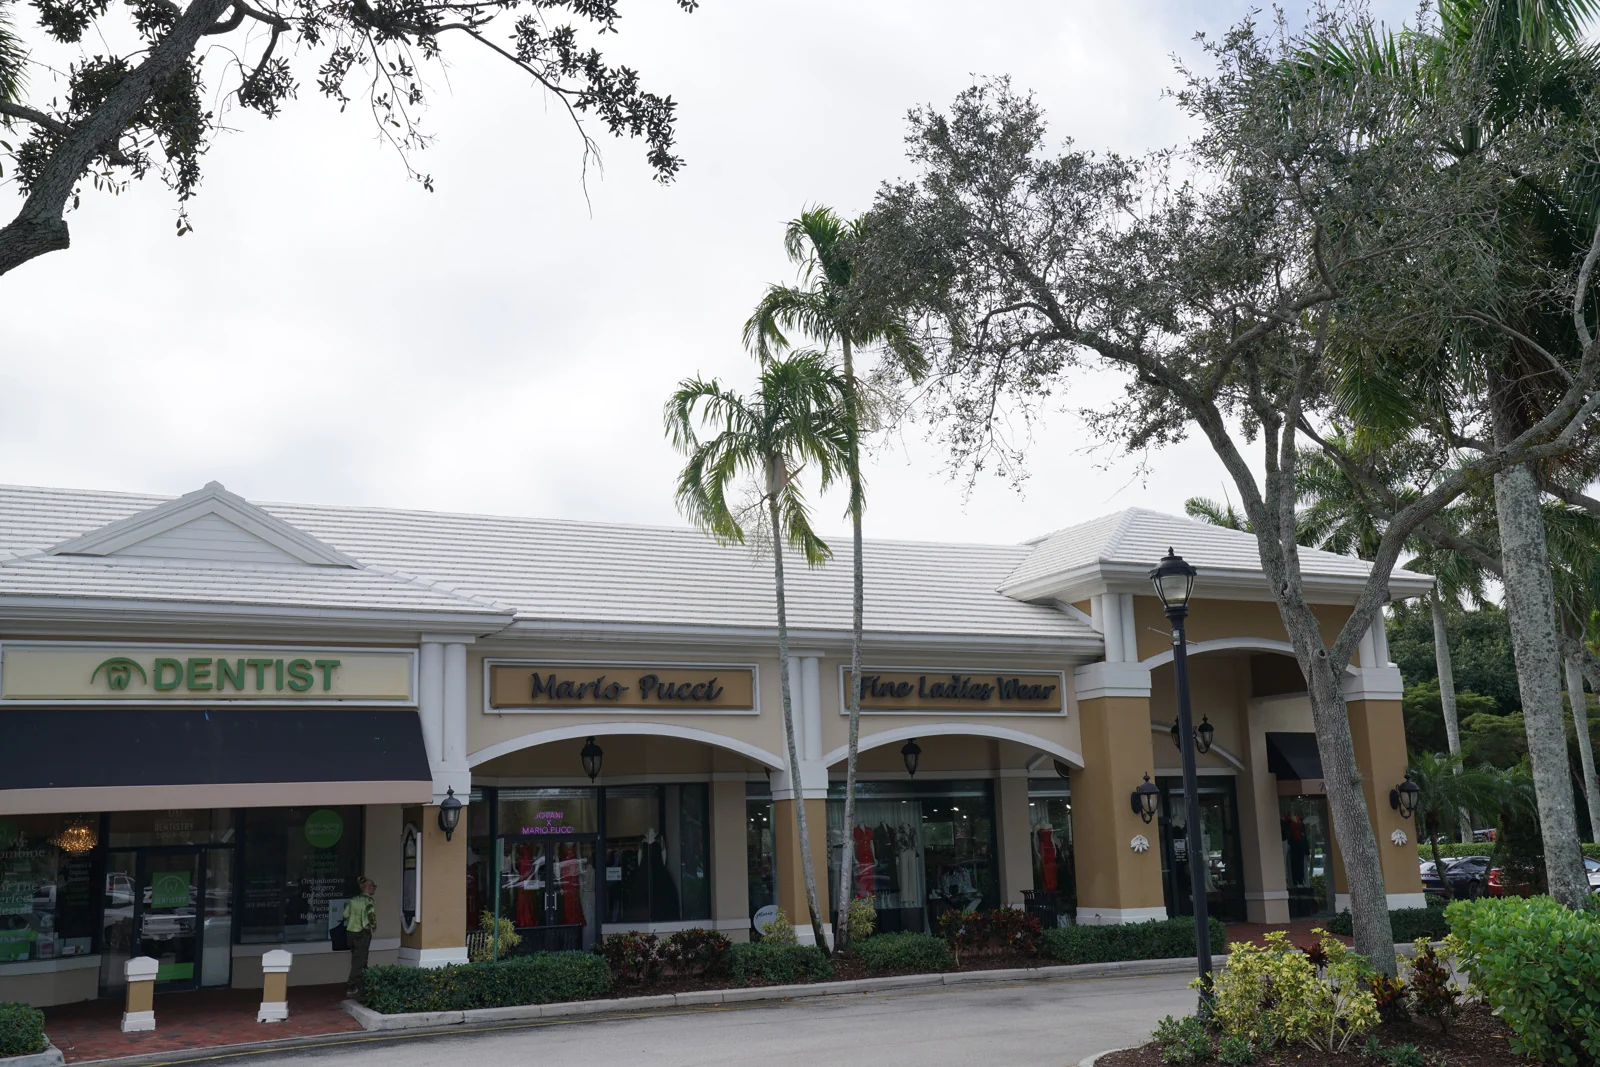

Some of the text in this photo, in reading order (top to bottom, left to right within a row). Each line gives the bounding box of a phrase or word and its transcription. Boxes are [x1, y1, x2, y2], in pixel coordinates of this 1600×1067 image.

[154, 658, 340, 691] DENTIST
[532, 672, 723, 701] Mario Pucci
[860, 675, 1056, 701] Fine Ladies Wear
[535, 811, 563, 819] JOVANI
[154, 822, 194, 832] DENTISTRY
[522, 827, 548, 835] MARIO
